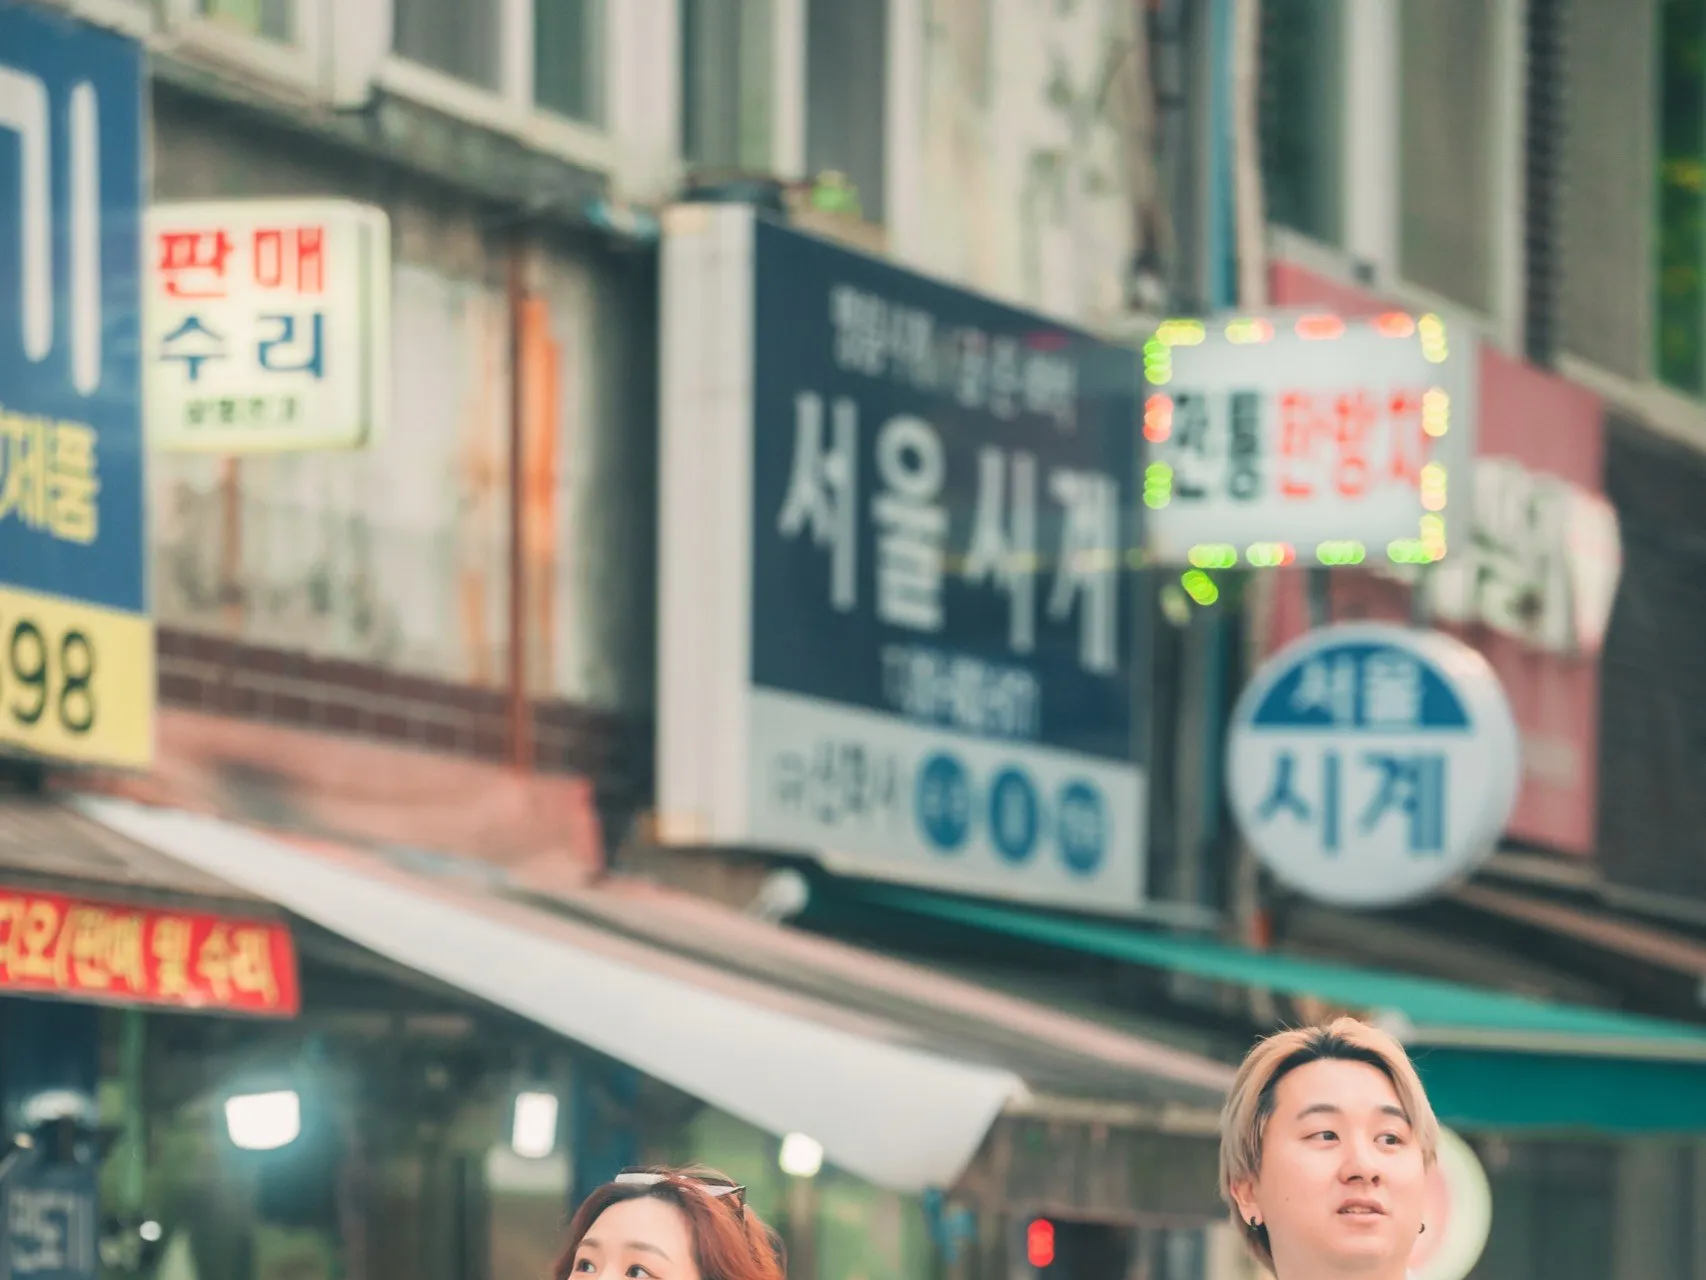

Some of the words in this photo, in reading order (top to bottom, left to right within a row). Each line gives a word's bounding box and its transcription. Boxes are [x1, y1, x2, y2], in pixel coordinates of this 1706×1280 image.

[159, 228, 324, 299] 판매
[159, 311, 324, 382] 수리
[778, 390, 1120, 674] 서울시계
[10, 619, 97, 736] 98
[1290, 652, 1422, 728] 서울
[1257, 749, 1448, 857] 시계
